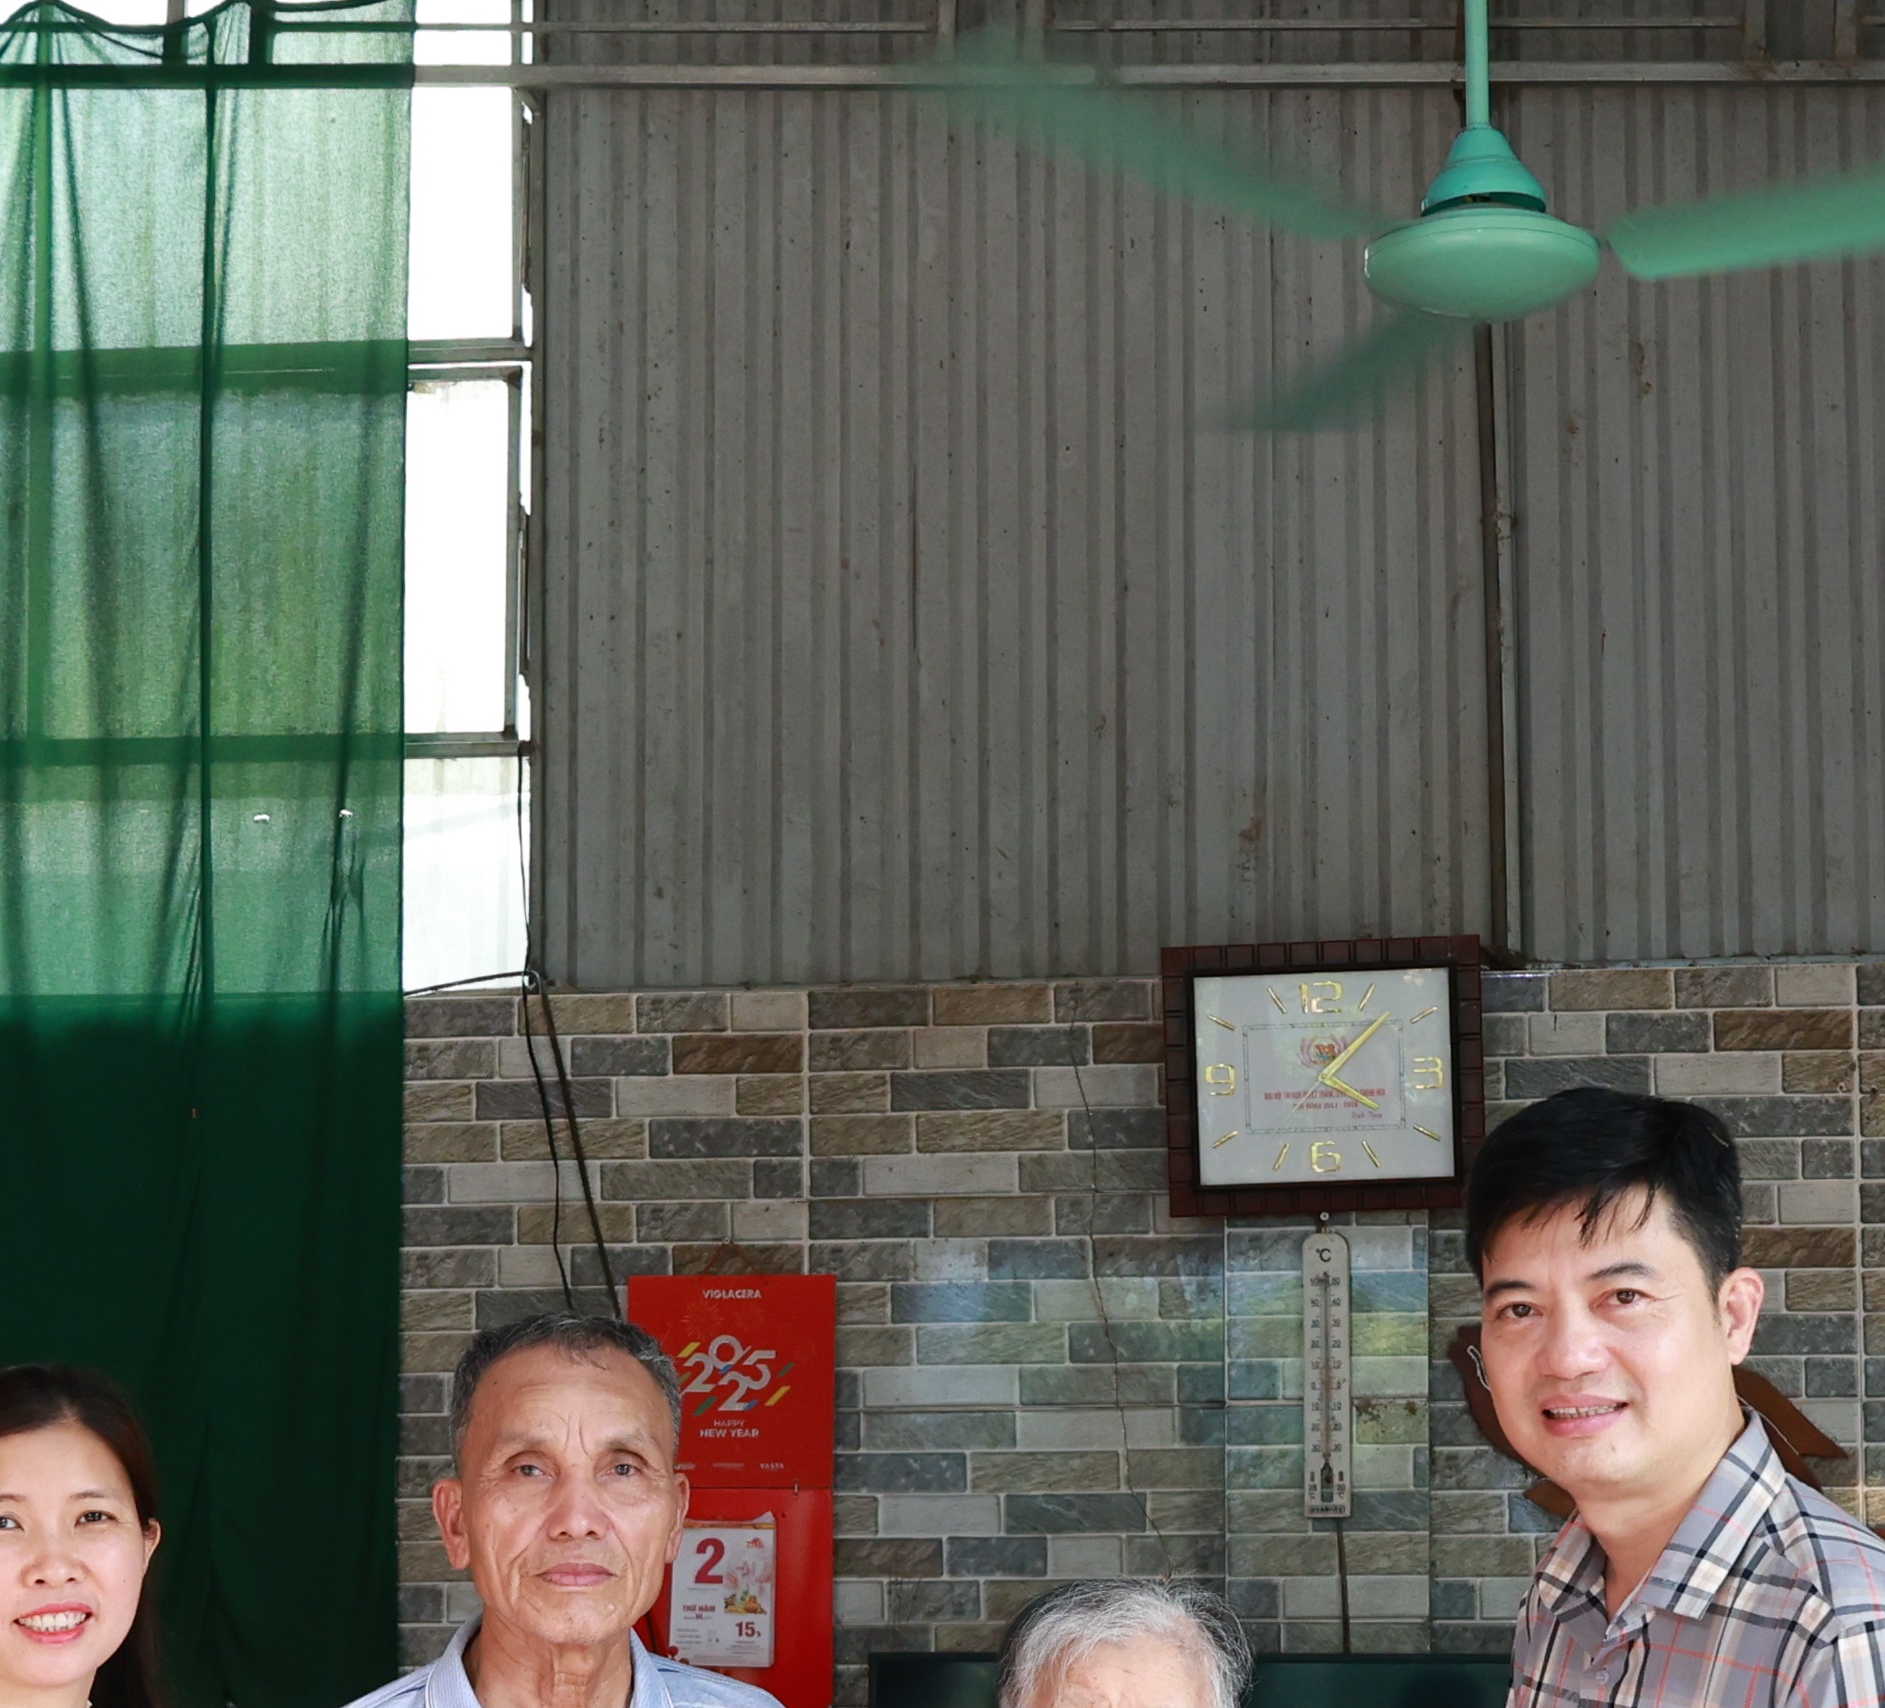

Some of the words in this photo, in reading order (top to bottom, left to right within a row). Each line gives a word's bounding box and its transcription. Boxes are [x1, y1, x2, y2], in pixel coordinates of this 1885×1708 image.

[1299, 980, 1343, 1014] 12
[1205, 1063, 1236, 1097] 9
[1412, 1056, 1444, 1090] 3
[1310, 1140, 1342, 1173] 6
[702, 1289, 762, 1299] VIGLACERA
[700, 1428, 727, 1438] NEW
[730, 1428, 760, 1438] YEAR
[713, 1419, 745, 1427] HAPPY
[694, 1538, 725, 1584] 2
